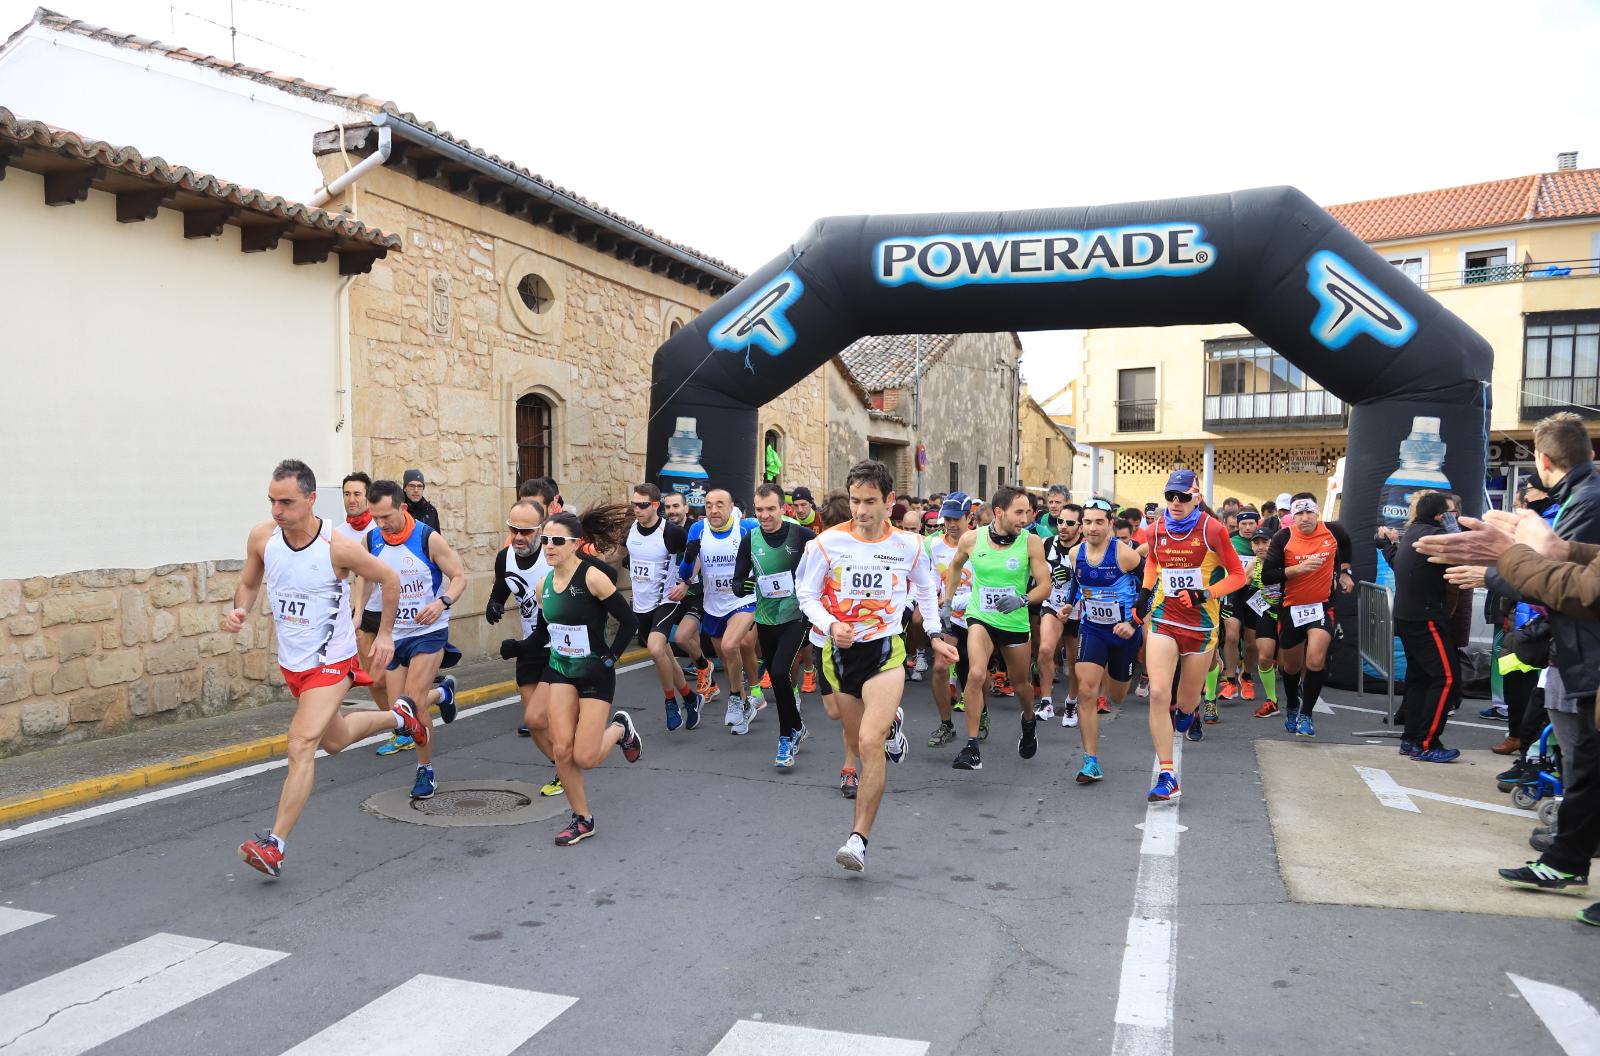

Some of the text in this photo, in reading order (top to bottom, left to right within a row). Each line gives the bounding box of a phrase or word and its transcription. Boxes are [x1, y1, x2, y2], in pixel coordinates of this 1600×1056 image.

[633, 566, 649, 576] 472
[715, 579, 733, 588] 649
[772, 580, 780, 590] 8
[852, 572, 883, 588] 602
[1170, 576, 1194, 588] 882
[399, 579, 424, 594] anik
[278, 599, 306, 616] 747
[396, 607, 418, 619] 220
[1091, 606, 1112, 617] 300
[1297, 607, 1316, 618] 154
[564, 633, 571, 646] 4
